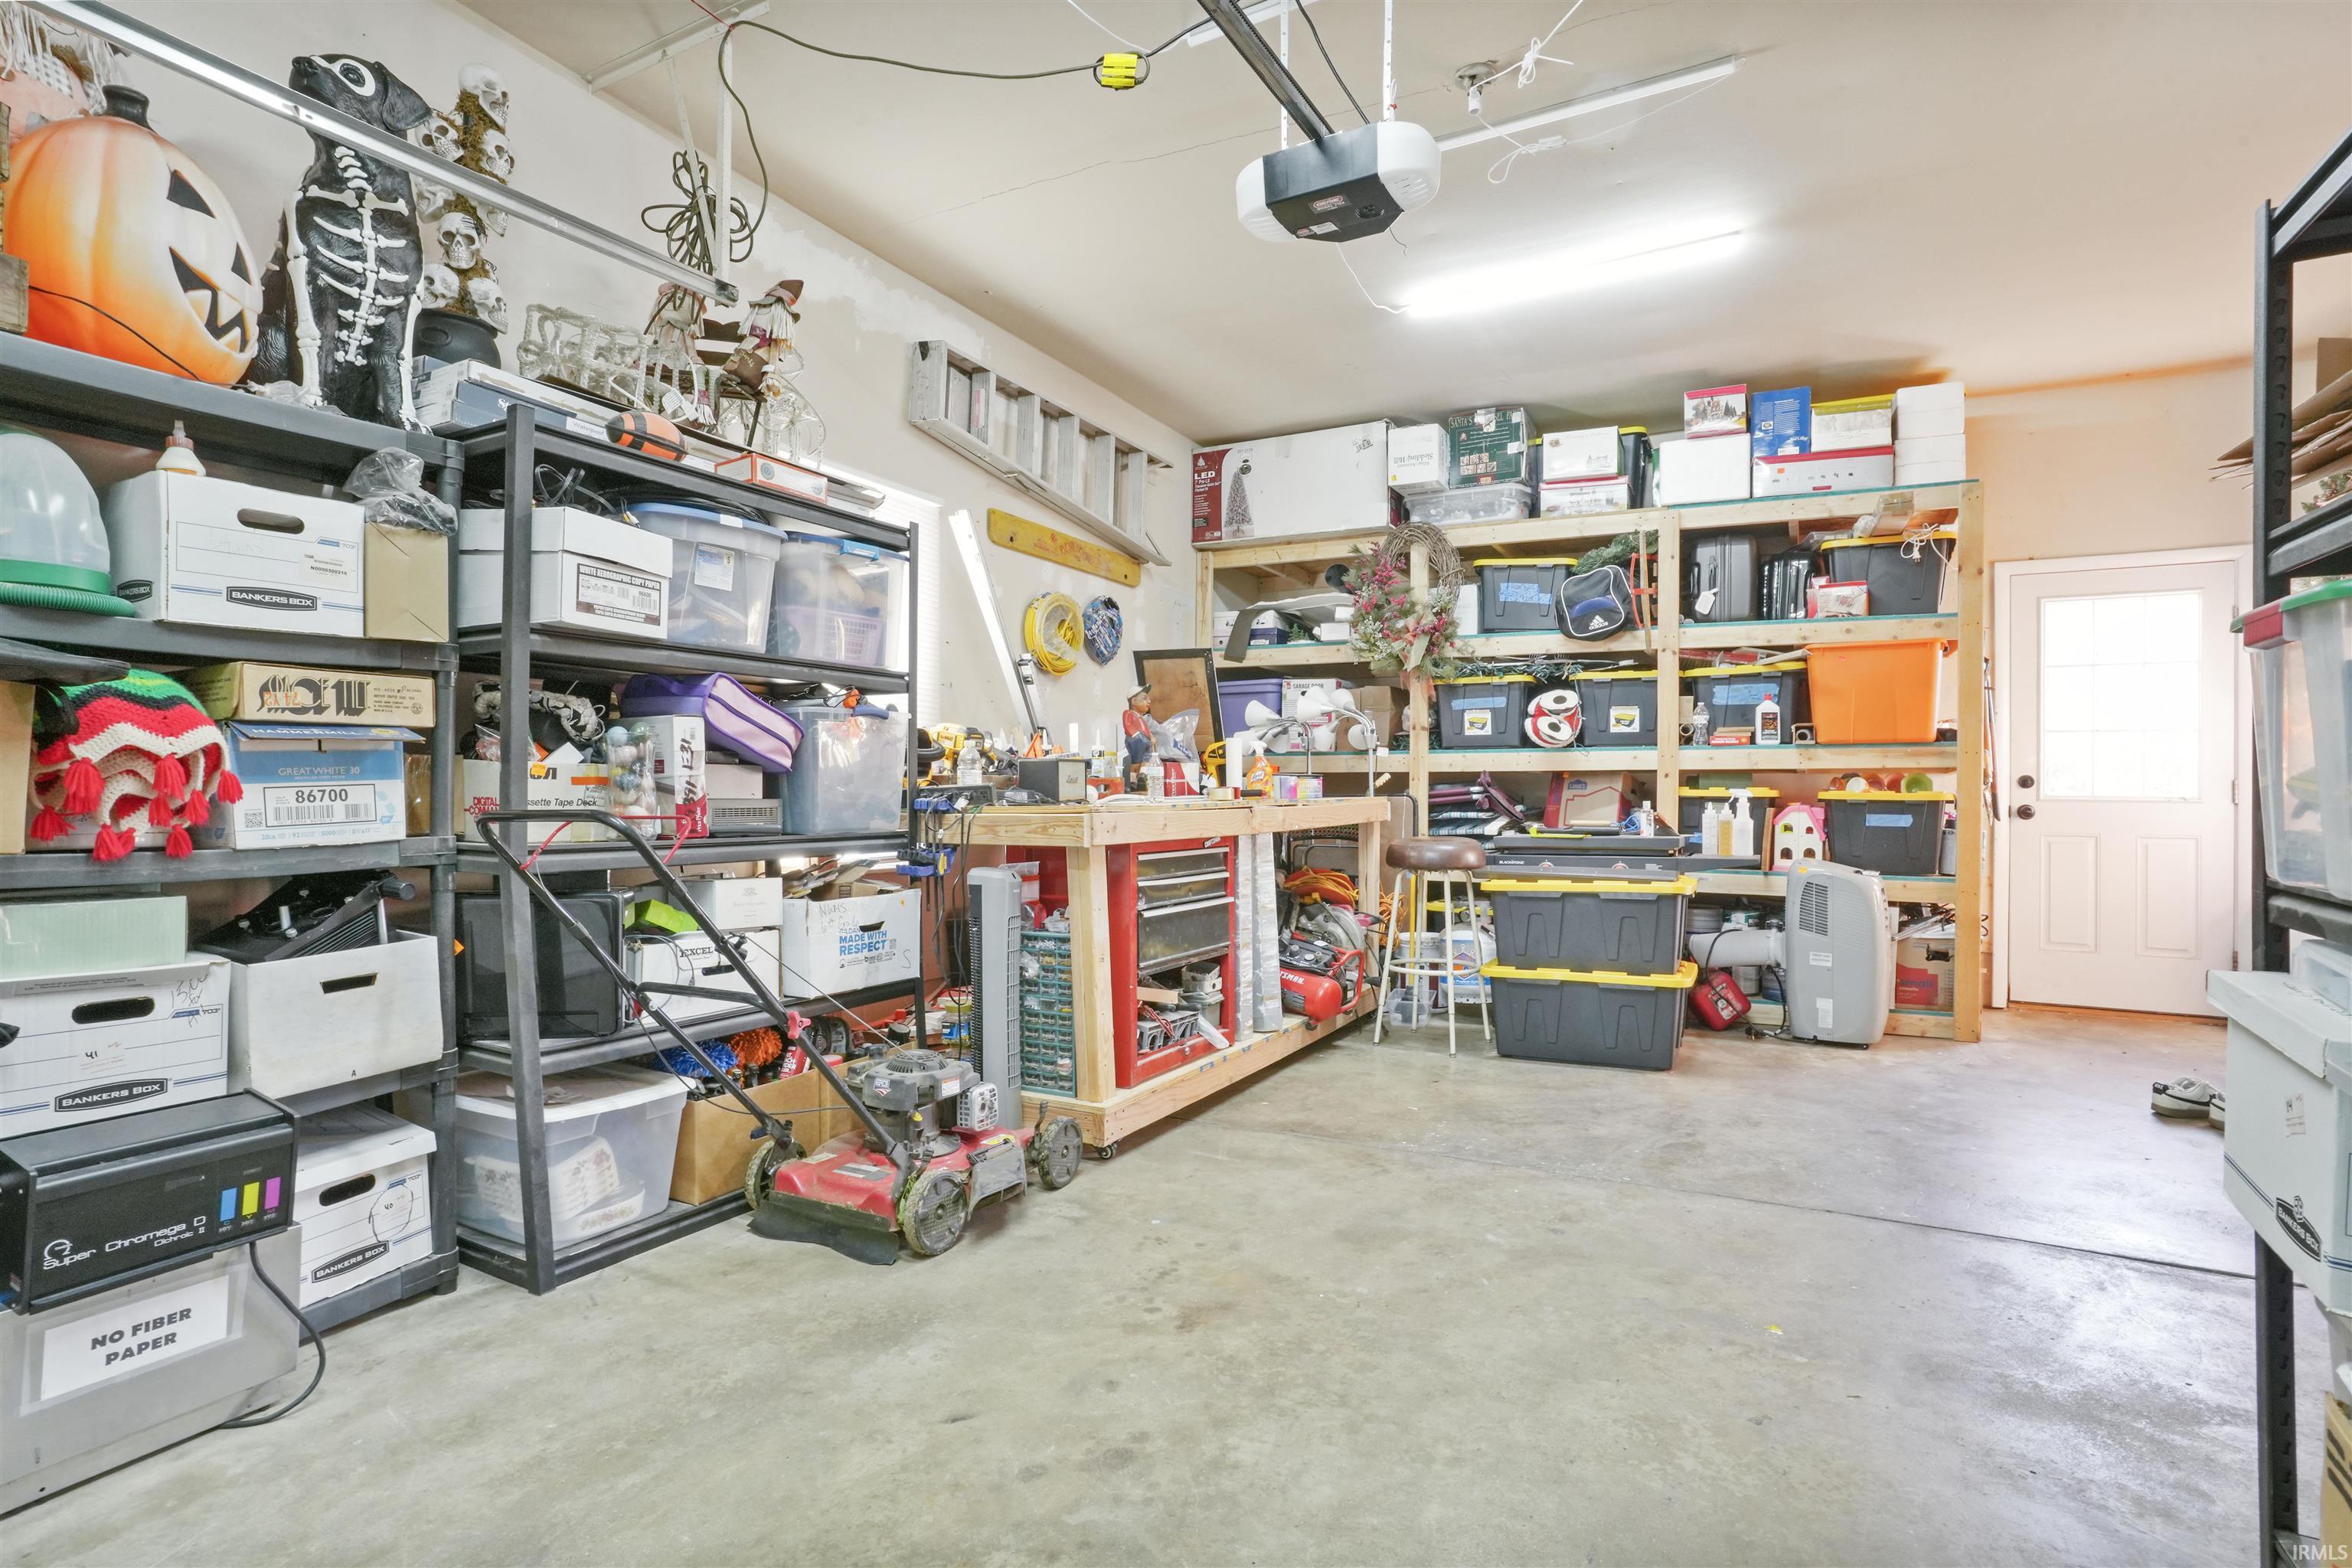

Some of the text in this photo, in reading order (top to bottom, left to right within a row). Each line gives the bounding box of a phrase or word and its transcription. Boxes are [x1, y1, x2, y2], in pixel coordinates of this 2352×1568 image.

[1450, 416, 1473, 429] SANTA'S
[1407, 452, 1433, 461] Sledding
[1194, 470, 1216, 480] LED
[579, 565, 658, 589] WHITE XEROGRAPHIC COPY PAPER
[118, 585, 151, 597] BANKERS BOX
[232, 590, 313, 607] BANKERS BOX
[1589, 621, 1609, 630] adidas
[332, 678, 371, 716] TILT
[253, 727, 362, 736] HAMMERMILL
[278, 767, 309, 776] GREAT
[312, 766, 346, 775] WHITE
[295, 789, 348, 804] 86700
[473, 796, 500, 806] DIGITAL
[527, 798, 597, 808] ssette Tape Deck
[839, 930, 887, 944] MADE WITH
[839, 939, 887, 956] RESPECT
[61, 1083, 161, 1107] BANKERS BOX
[2278, 1206, 2320, 1253] BANKERS BOX
[43, 1249, 96, 1270] Super
[105, 1223, 186, 1253] Chromega
[194, 1216, 206, 1227] D
[154, 1230, 193, 1247] Dichroic
[316, 1246, 385, 1278] BANKERS BOX
[91, 1308, 192, 1350] NO FIBER
[105, 1332, 177, 1366] PAPER
